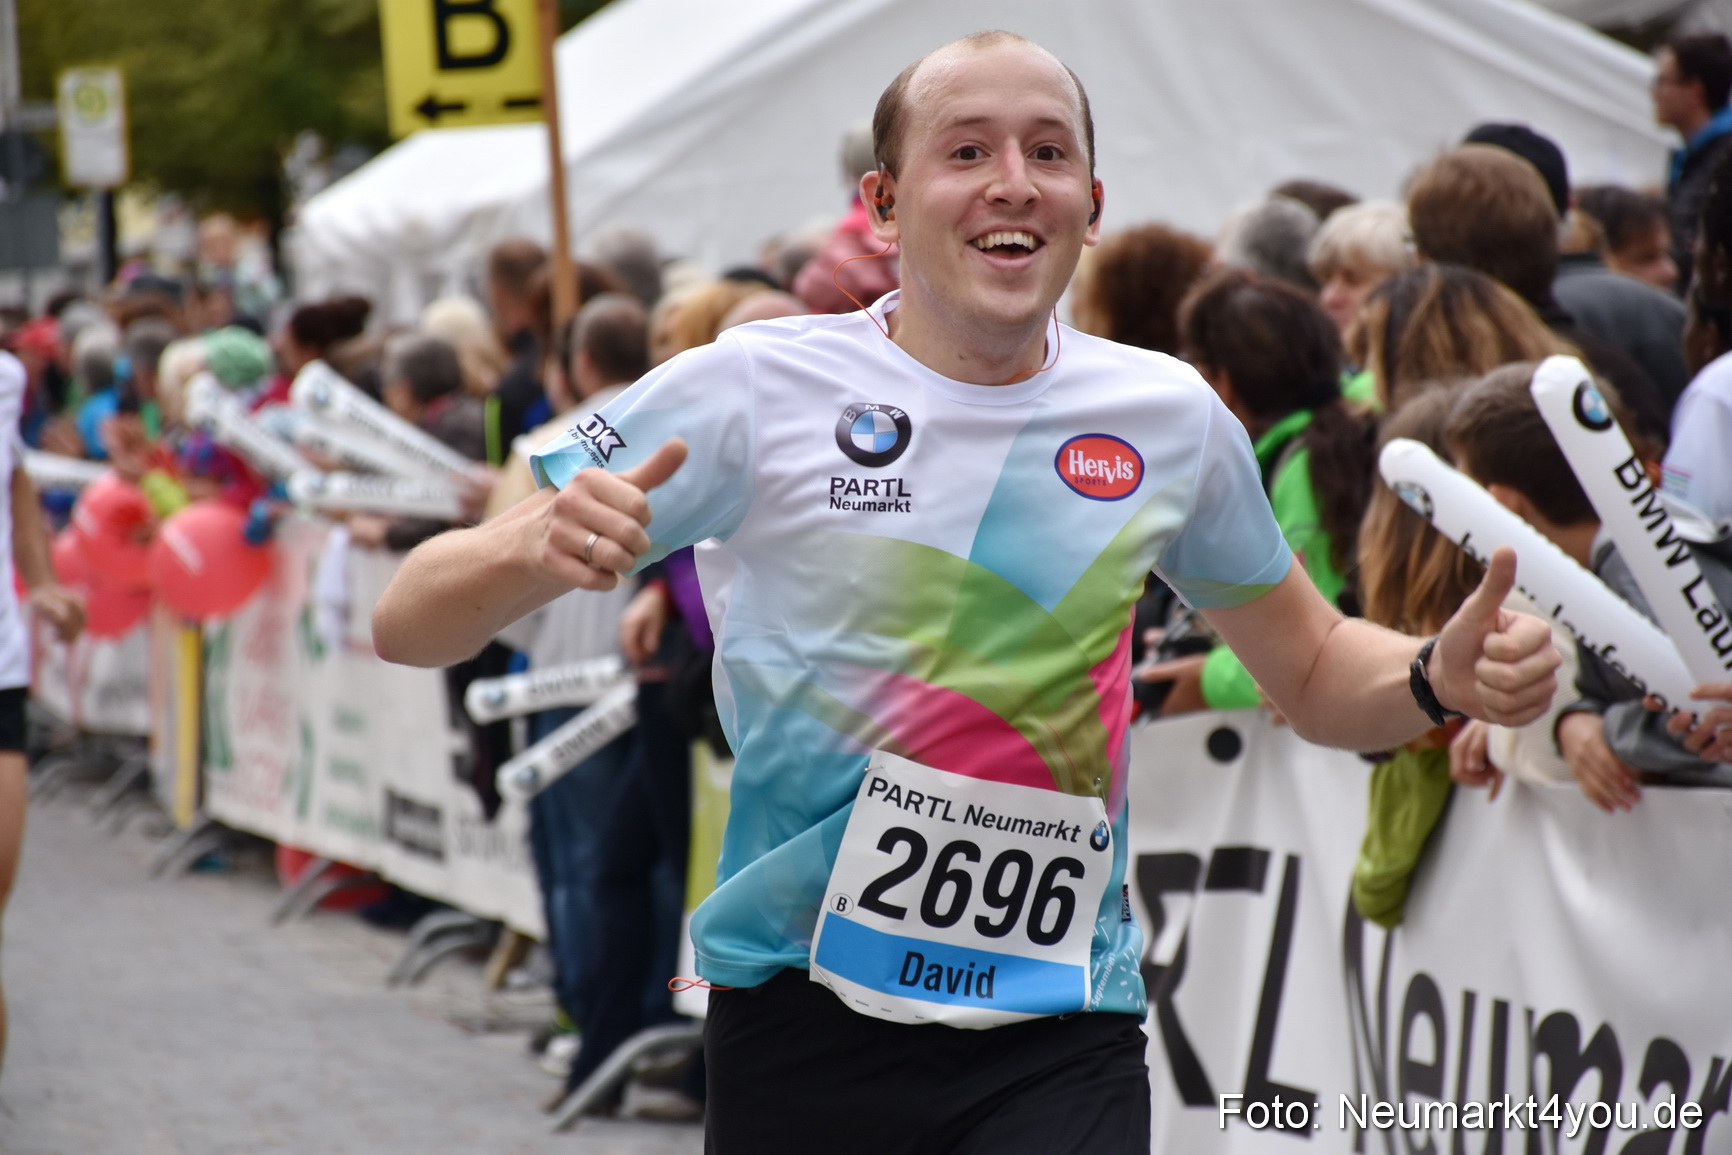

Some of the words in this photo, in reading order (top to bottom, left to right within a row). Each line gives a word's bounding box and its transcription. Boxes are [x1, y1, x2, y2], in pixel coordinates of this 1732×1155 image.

[433, 0, 510, 70] B
[843, 404, 905, 424] BMW
[1069, 449, 1134, 484] Hervis
[1074, 476, 1107, 487] SPORTS
[830, 477, 912, 498] PARTL
[830, 496, 911, 513] Neumarkt
[1613, 456, 1692, 568] BMW
[1681, 575, 1732, 670] Lau
[867, 776, 957, 823] PARTL
[963, 804, 1082, 843] Neumarkt
[857, 826, 1085, 946] 2696
[835, 896, 848, 913] B
[898, 950, 998, 1000] David
